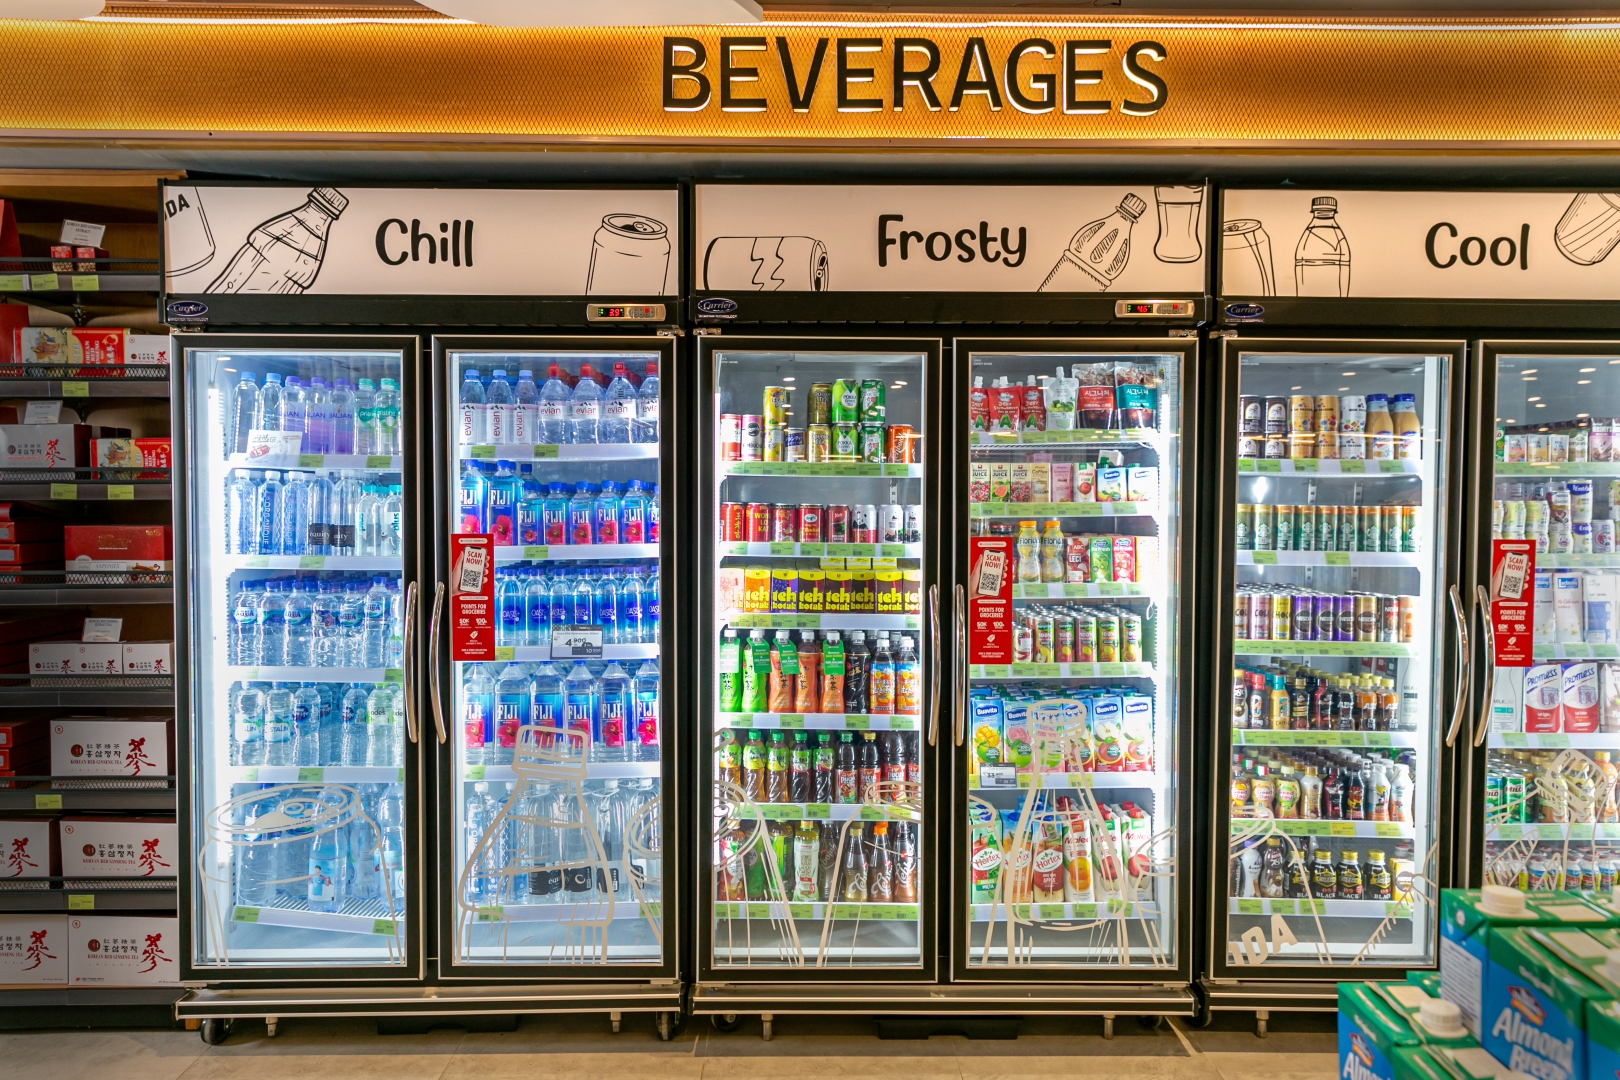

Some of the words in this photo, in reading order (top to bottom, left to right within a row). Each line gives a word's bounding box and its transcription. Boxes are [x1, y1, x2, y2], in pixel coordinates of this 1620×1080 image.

[663, 36, 1168, 116] BEVERAGES
[165, 193, 190, 222] DA
[375, 218, 474, 268] Chill
[879, 214, 1027, 268] Frosty
[1425, 221, 1530, 271] Cool
[173, 303, 203, 317] Carrier
[702, 299, 735, 315] Carrier
[1230, 302, 1261, 316] Carrier
[541, 406, 562, 415] evian
[576, 406, 597, 415] evian
[607, 405, 628, 414] evian
[643, 404, 658, 413] evia
[464, 410, 472, 436] evian
[493, 410, 501, 437] evian
[490, 490, 511, 506] FIJI
[519, 511, 536, 523] FIJI
[545, 511, 564, 523] FIJI
[572, 511, 590, 524] FIJI
[598, 508, 616, 521] FIJI
[624, 509, 642, 522] FIJI
[466, 557, 483, 566] NOW!
[467, 551, 483, 559] SCAN
[986, 554, 1001, 562] SCAN
[1508, 556, 1524, 564] SCAN
[984, 561, 1001, 569] NOW!
[1506, 563, 1524, 572] NOW!
[746, 586, 769, 601] teh
[772, 587, 796, 602] teh
[799, 587, 824, 602] teh
[825, 587, 850, 602] teh
[850, 587, 874, 602] teh
[878, 587, 902, 602] teh
[772, 602, 796, 611] kotak
[798, 602, 823, 611] kotak
[825, 602, 850, 611] kotak
[850, 602, 874, 611] kotak
[877, 602, 902, 611] kotak
[497, 704, 518, 720] FIJI
[533, 704, 553, 720] FIJI
[568, 704, 587, 721] FIJI
[602, 703, 621, 720] FIJI
[638, 702, 654, 717] FIJ
[975, 854, 1001, 868] Hortex
[1035, 854, 1062, 870] Hortex
[102, 945, 138, 953] 홍삼정차
[1492, 1007, 1575, 1075] Almond
